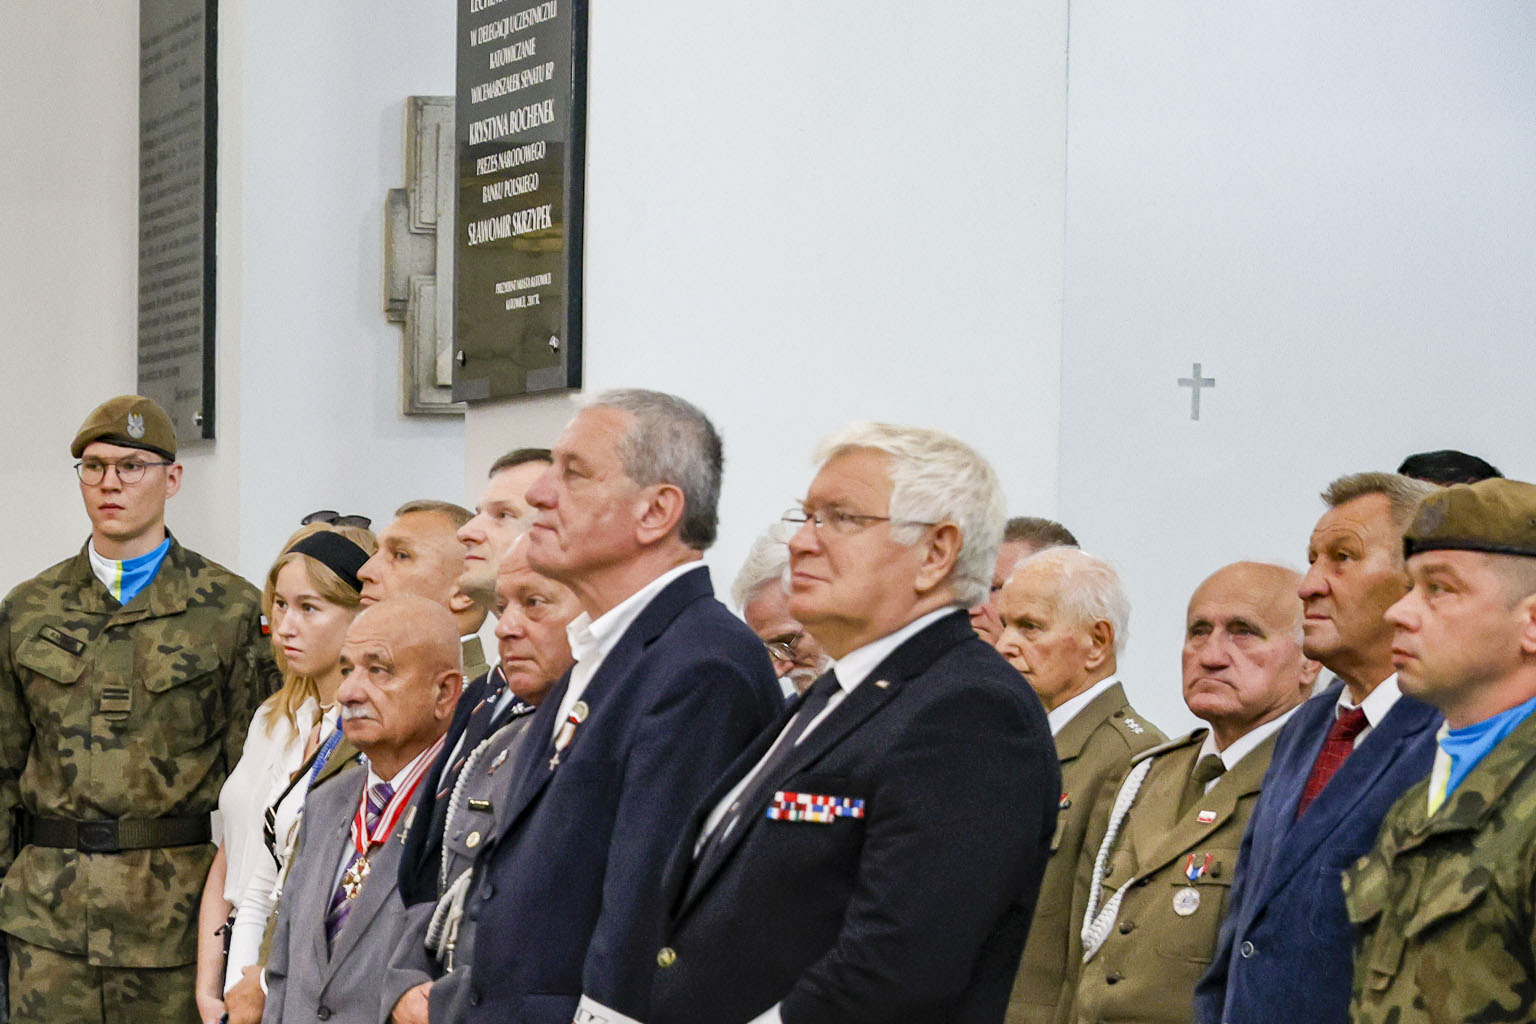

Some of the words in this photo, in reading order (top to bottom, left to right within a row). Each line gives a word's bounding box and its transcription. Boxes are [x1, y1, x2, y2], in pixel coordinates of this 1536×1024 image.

[489, 36, 536, 70] KATOWICZANIE
[520, 64, 545, 89] SENATU
[545, 61, 555, 81] RP
[469, 113, 510, 146] KRYSTYNA
[509, 98, 556, 134] BOCHENEK
[476, 153, 499, 176] PREZES
[498, 140, 547, 170] NARODOWEGO
[482, 179, 504, 204] BANKU
[503, 171, 540, 198] POLSKIEGO
[467, 213, 512, 246] SŁAWOMIR
[512, 203, 553, 236] SKRZYPEK
